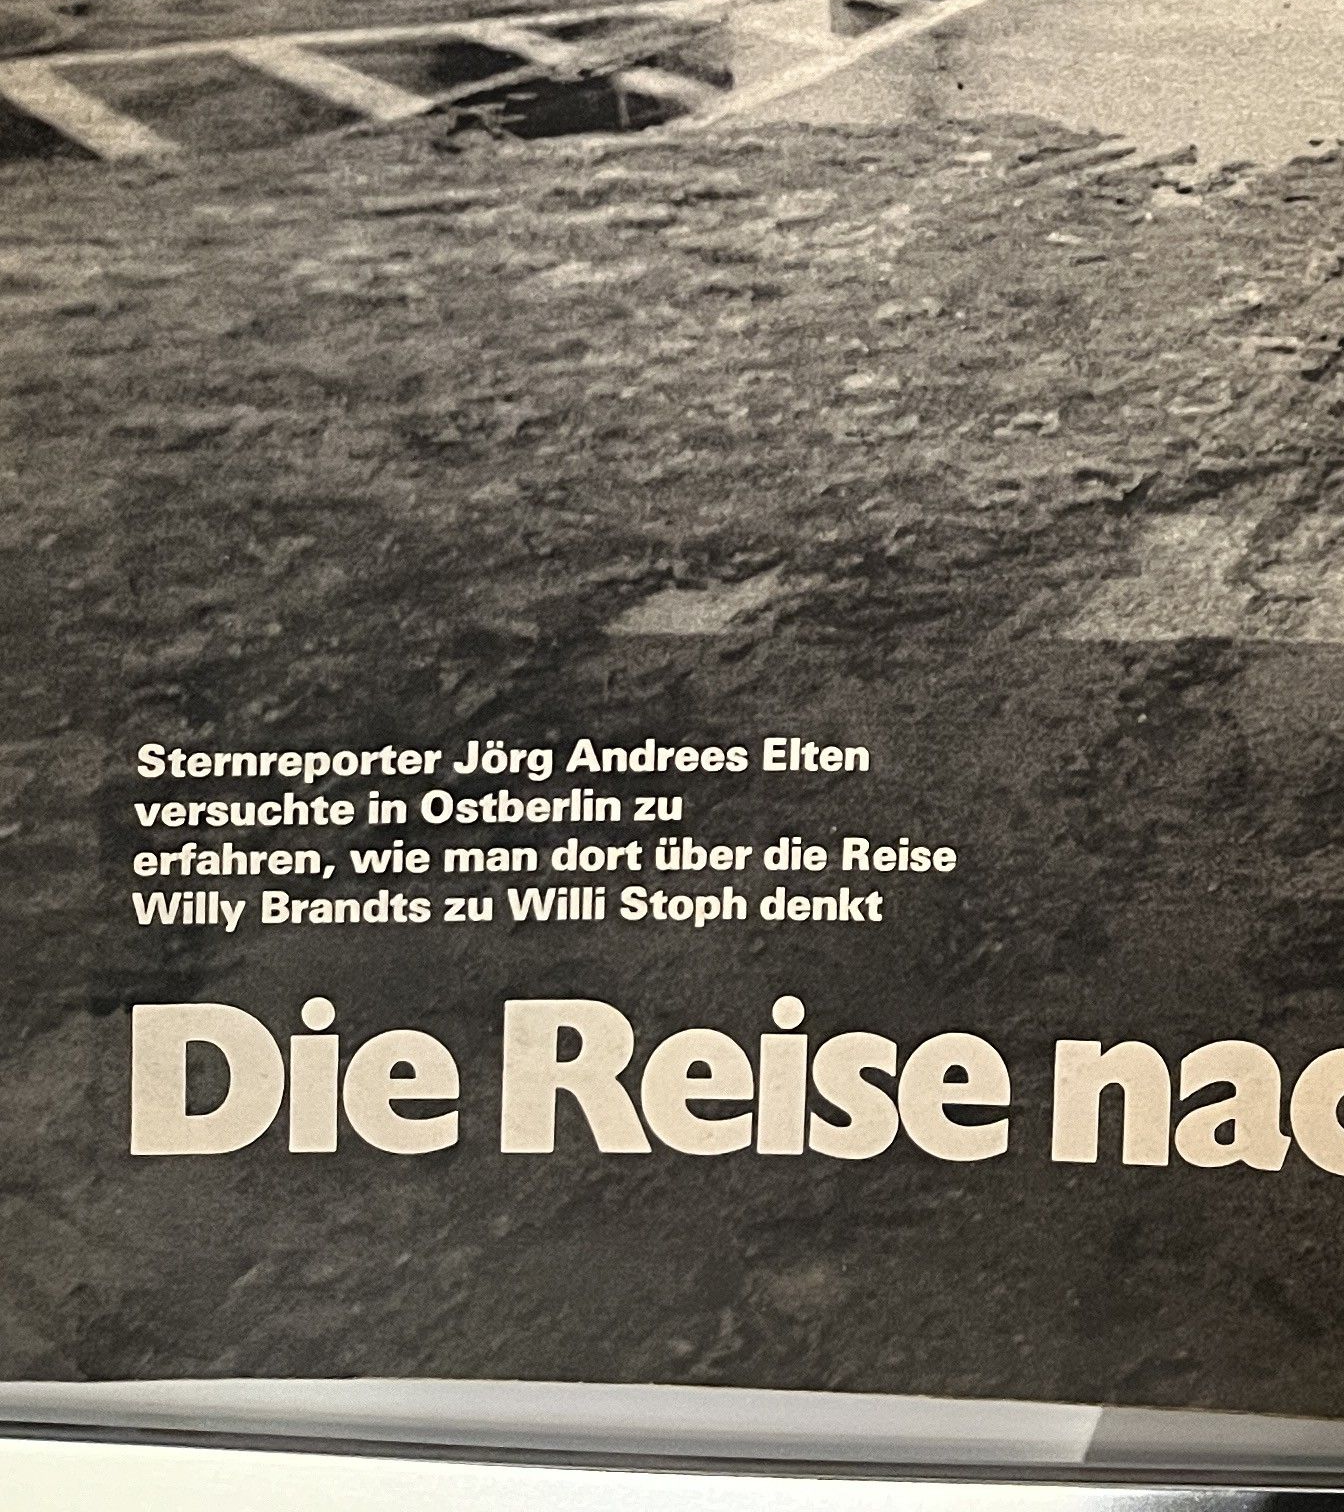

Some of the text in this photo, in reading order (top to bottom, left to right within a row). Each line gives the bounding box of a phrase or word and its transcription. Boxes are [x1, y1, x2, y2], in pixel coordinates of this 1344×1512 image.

[137, 737, 870, 784] Sternreporter Jörg Andrees Elten
[133, 788, 683, 827] versuchte in Ostberlin zu
[133, 836, 957, 880] erfahren, wie man dort über die Reise
[131, 885, 883, 933] Willy Brandts zu Willi Stoph denkt
[130, 996, 460, 1156] Die
[500, 995, 1011, 1162] Reise
